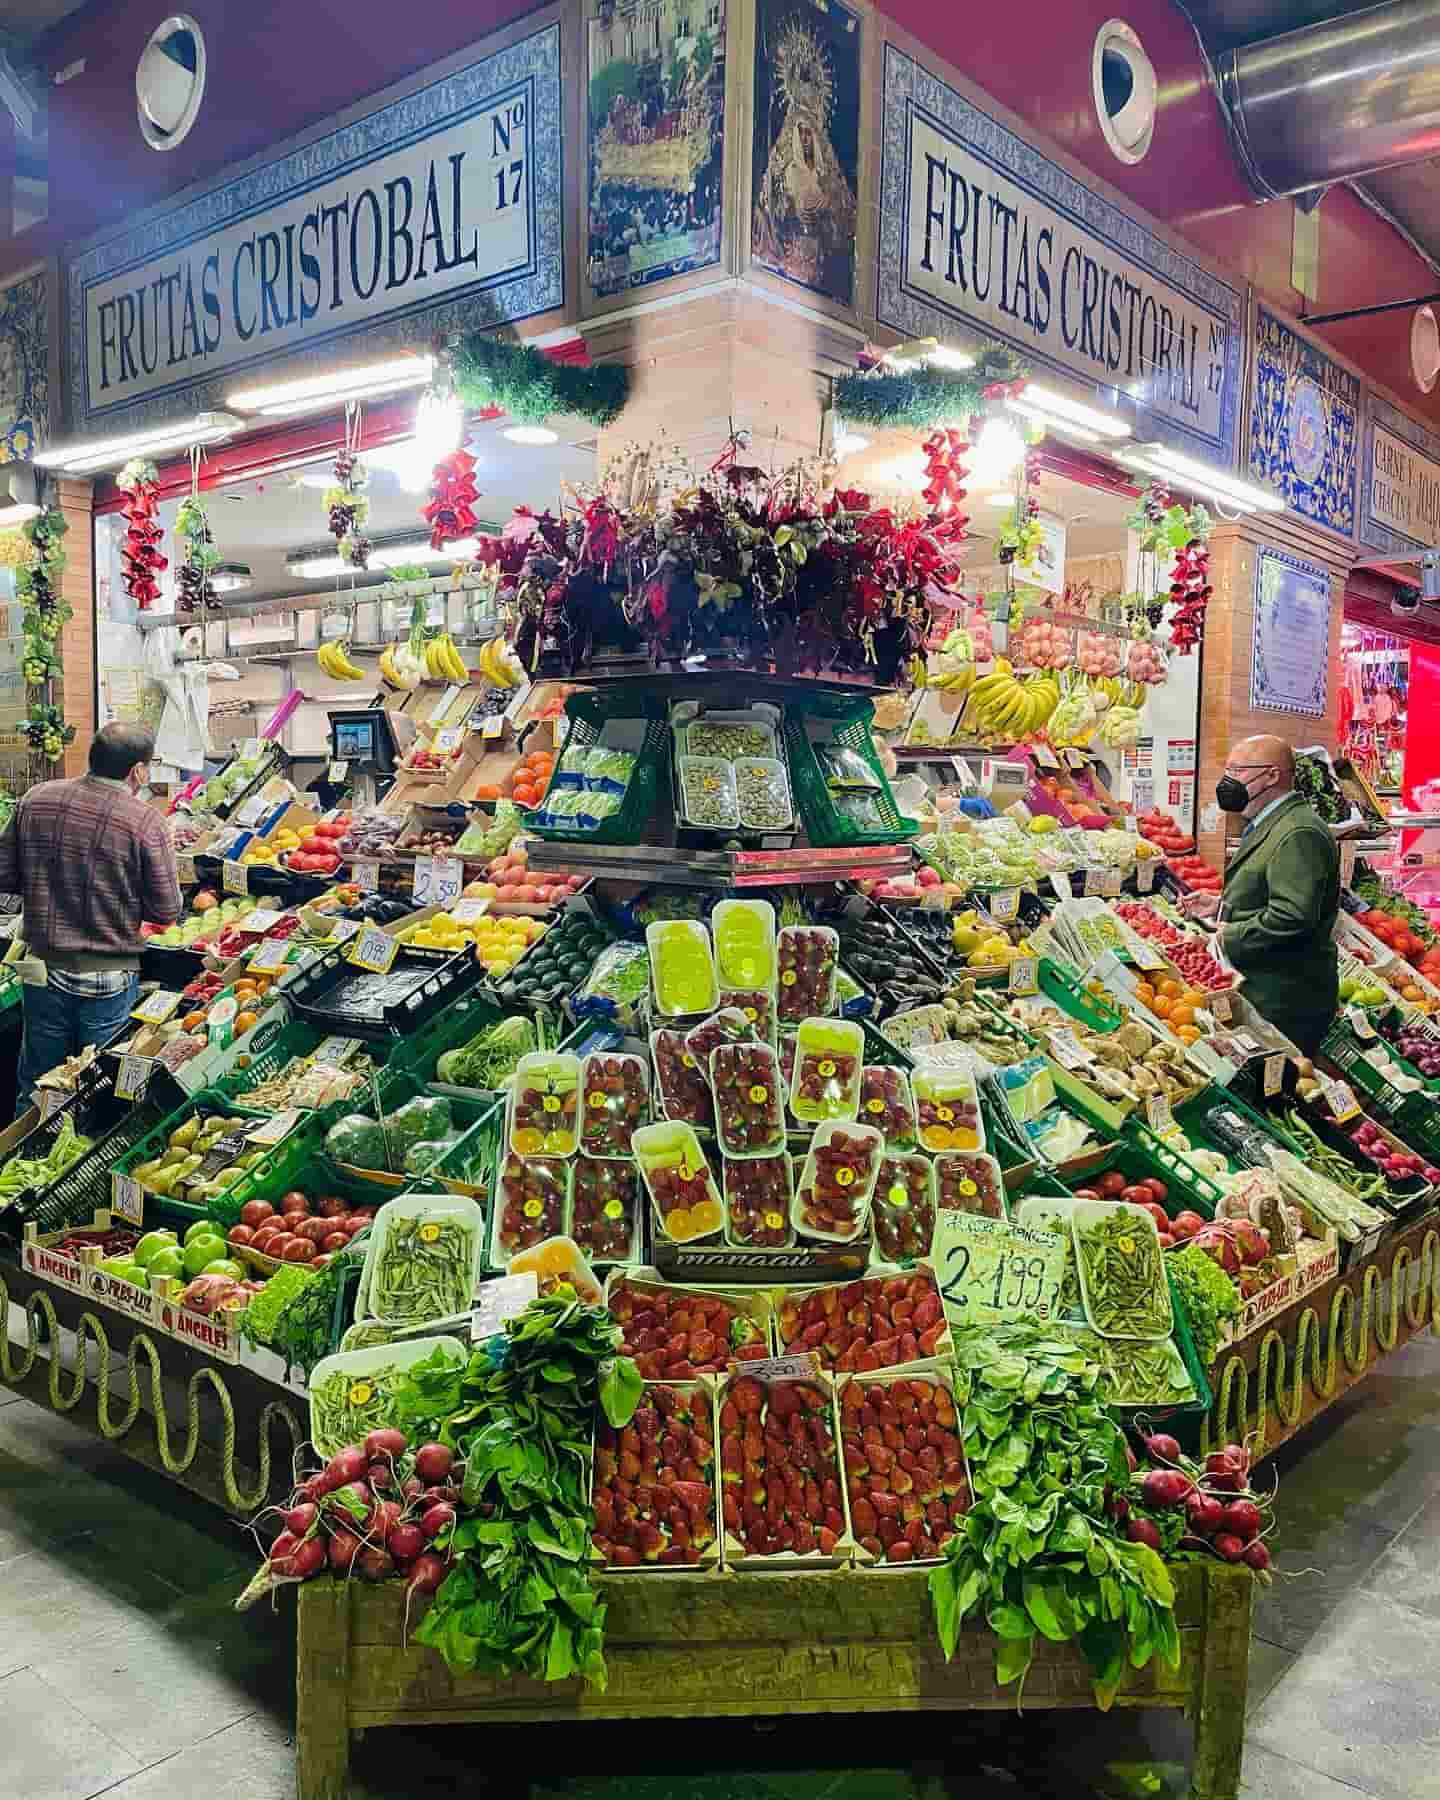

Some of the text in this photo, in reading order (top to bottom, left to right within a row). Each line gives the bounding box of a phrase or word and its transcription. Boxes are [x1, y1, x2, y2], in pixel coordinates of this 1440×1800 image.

[494, 160, 524, 210] 17
[98, 151, 479, 391] FRUTAS CRISTOBAL
[920, 152, 1202, 415] FRUTAS CRISTOBAL
[938, 1245, 970, 1306] 2
